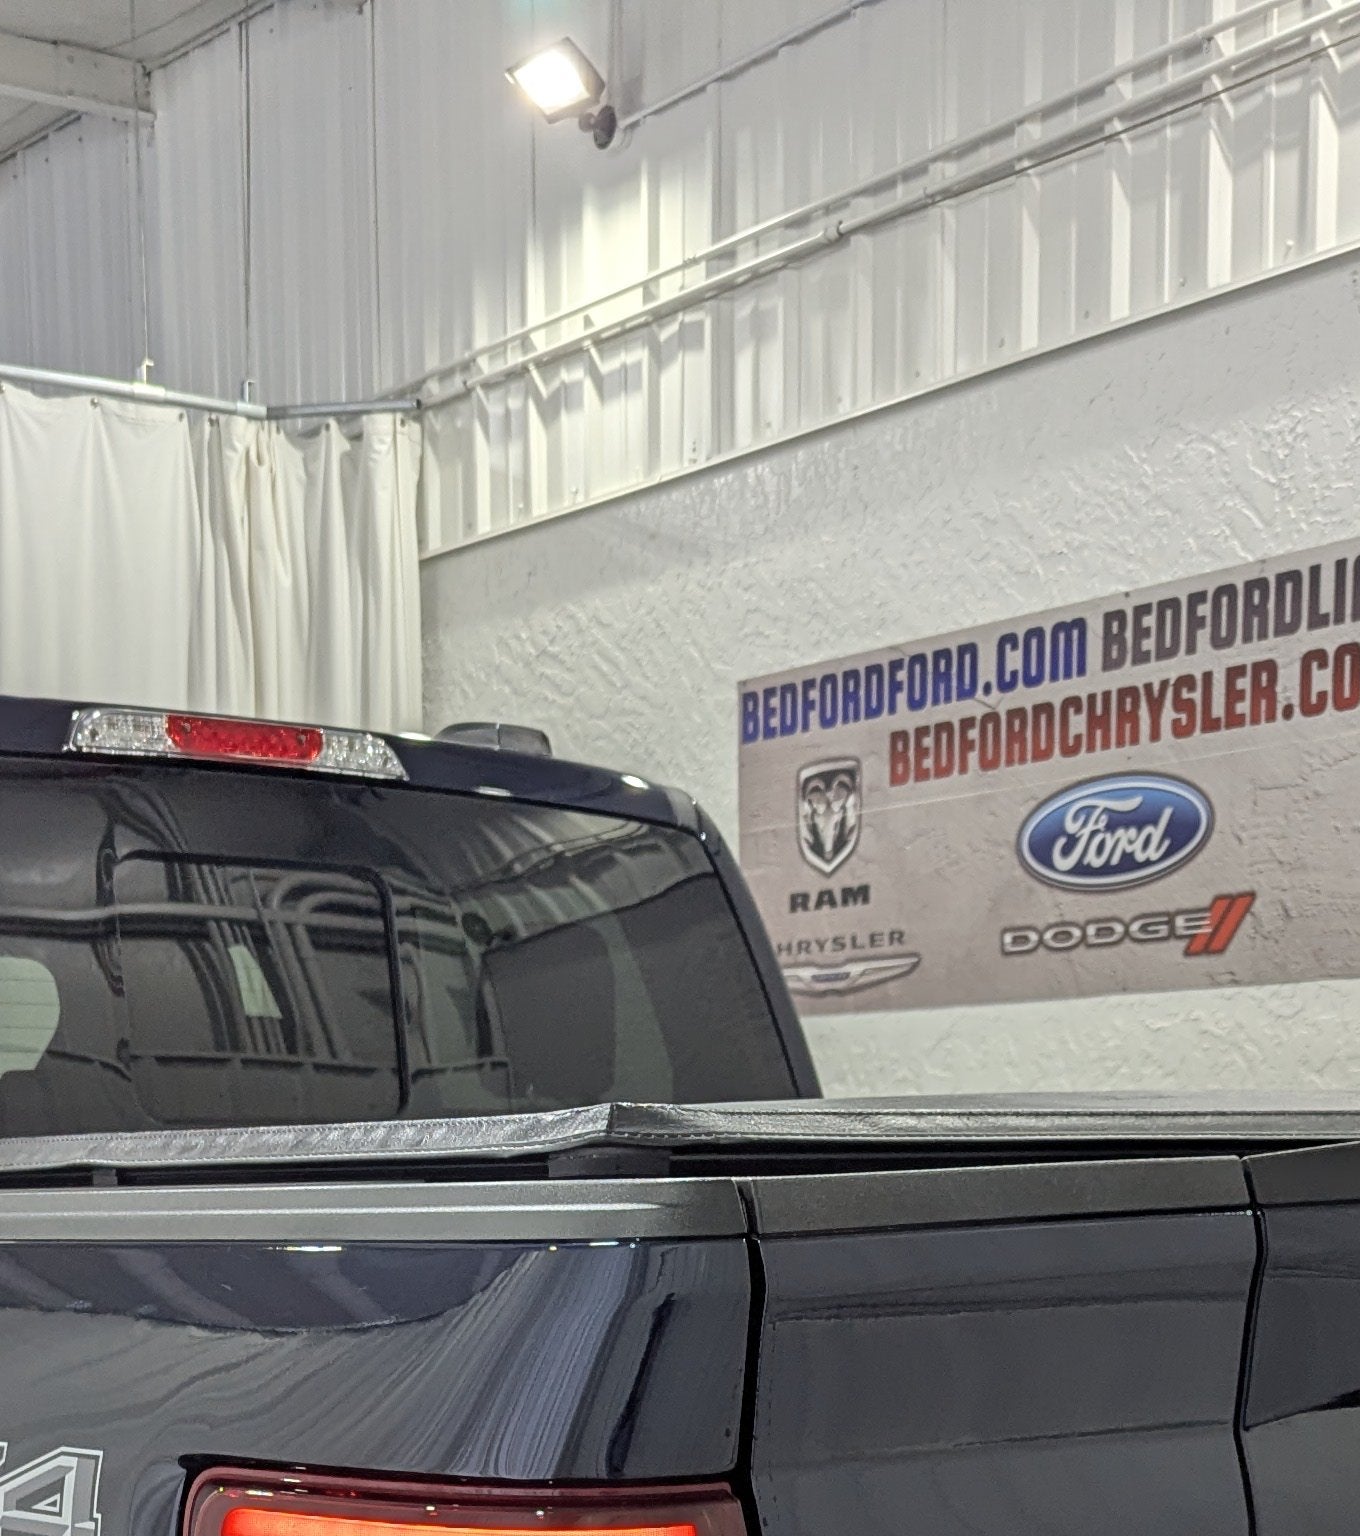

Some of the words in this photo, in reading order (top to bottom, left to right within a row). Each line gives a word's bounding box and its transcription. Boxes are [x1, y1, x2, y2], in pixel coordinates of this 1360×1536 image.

[742, 617, 1087, 744] BEDFORDFORD.COM
[1052, 796, 1174, 871] Ford
[789, 884, 871, 914] RAM
[775, 929, 905, 955] HRYSLER
[1001, 906, 1208, 955] DODGE
